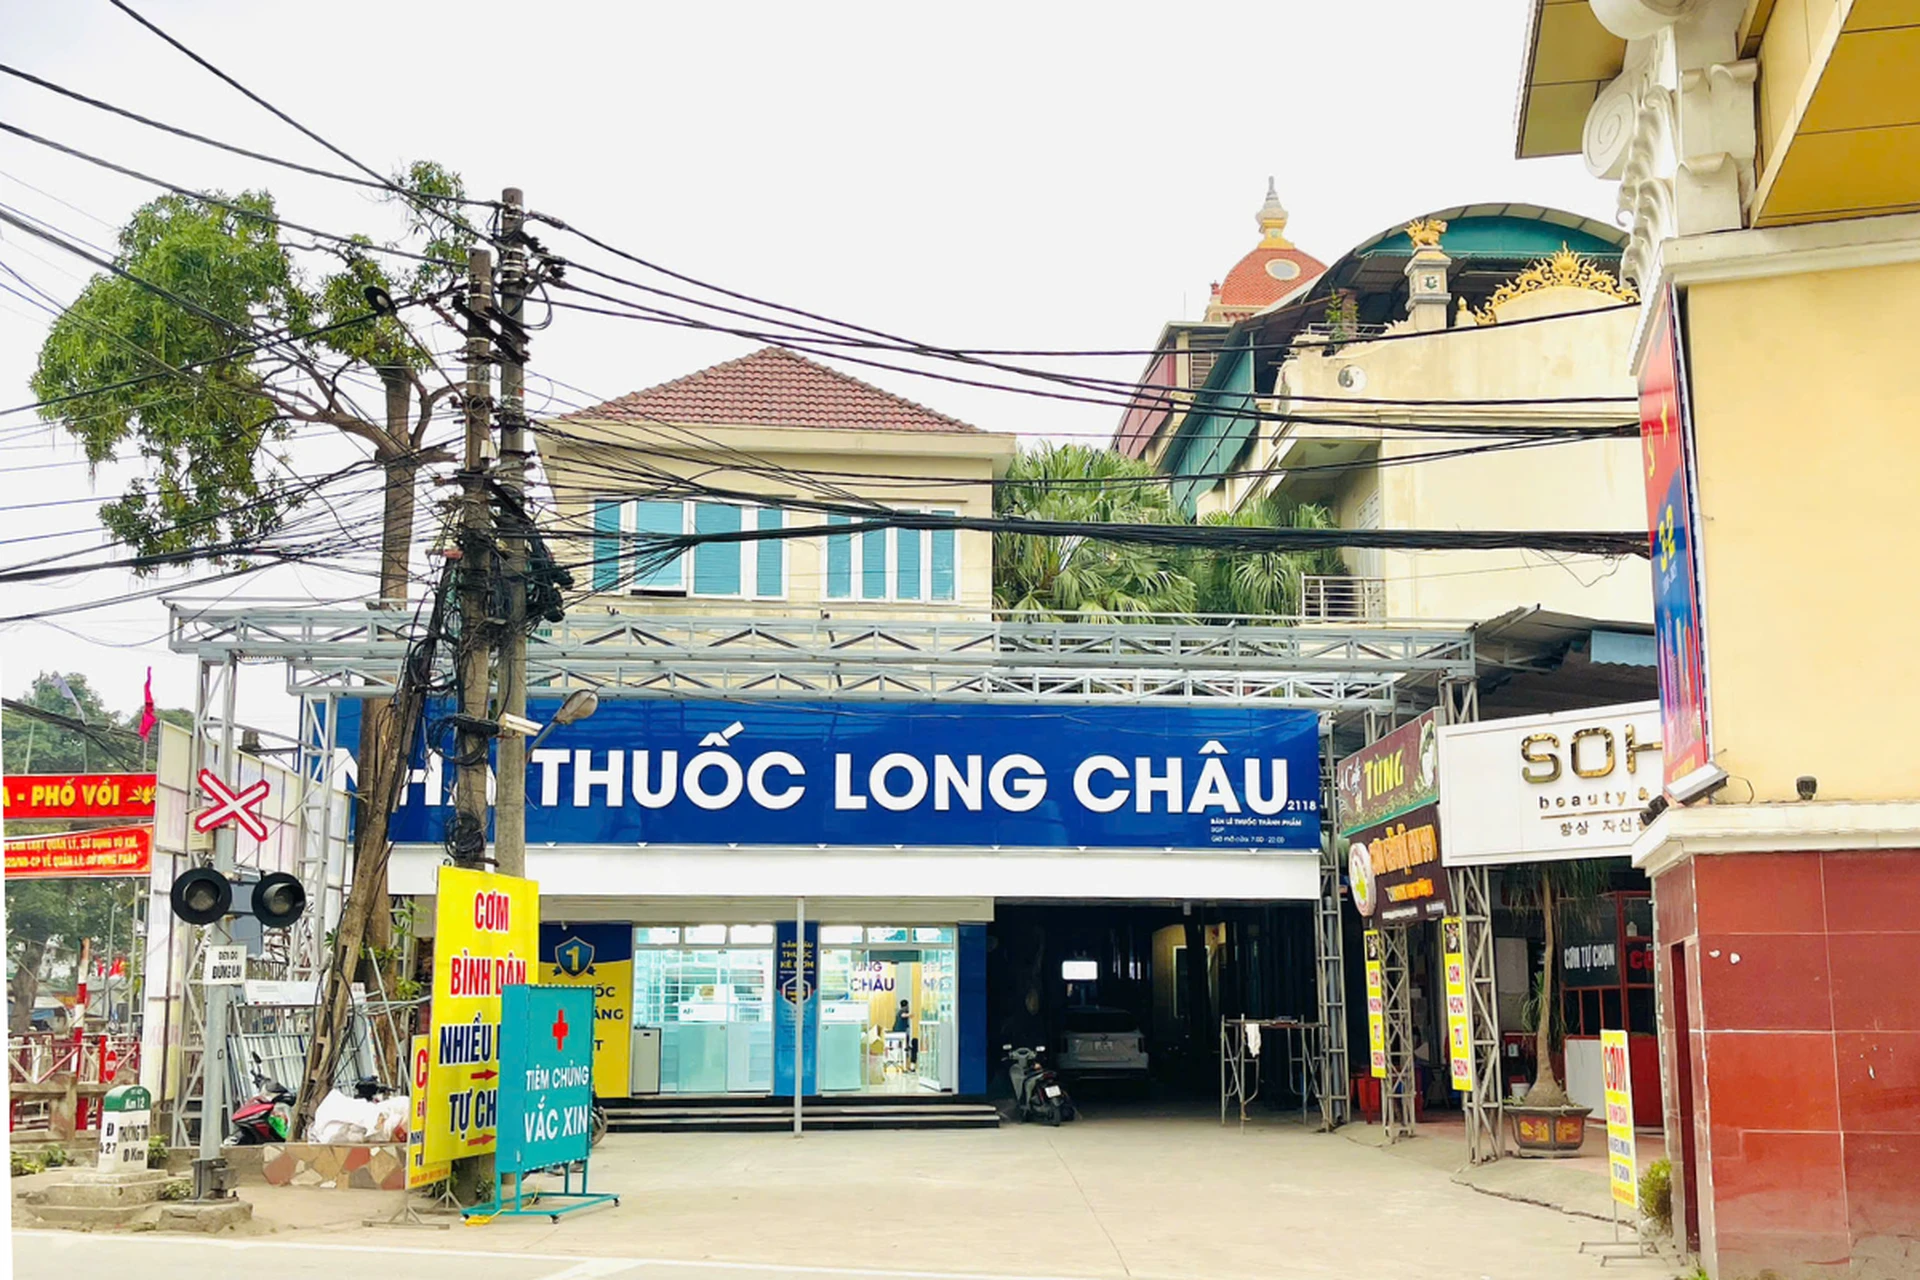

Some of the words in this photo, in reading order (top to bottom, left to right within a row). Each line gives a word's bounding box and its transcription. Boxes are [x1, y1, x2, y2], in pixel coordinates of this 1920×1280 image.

[531, 720, 806, 810] THUỐC
[834, 753, 1048, 811] LONG
[1073, 740, 1289, 814] CHÂU
[1287, 800, 1317, 811] 2118
[1364, 748, 1404, 800] TÙNG
[31, 777, 76, 807] PHỐ
[1539, 791, 1626, 809] beauty
[474, 891, 509, 931] CƠM
[450, 949, 491, 997] BÌNH
[439, 1012, 492, 1065] NHIỀU
[526, 1064, 550, 1092] TIÊM
[552, 1058, 590, 1086] CHỦNG
[449, 1089, 473, 1140] TỰ
[524, 1095, 558, 1144] VẮC
[564, 1103, 589, 1136] XIN
